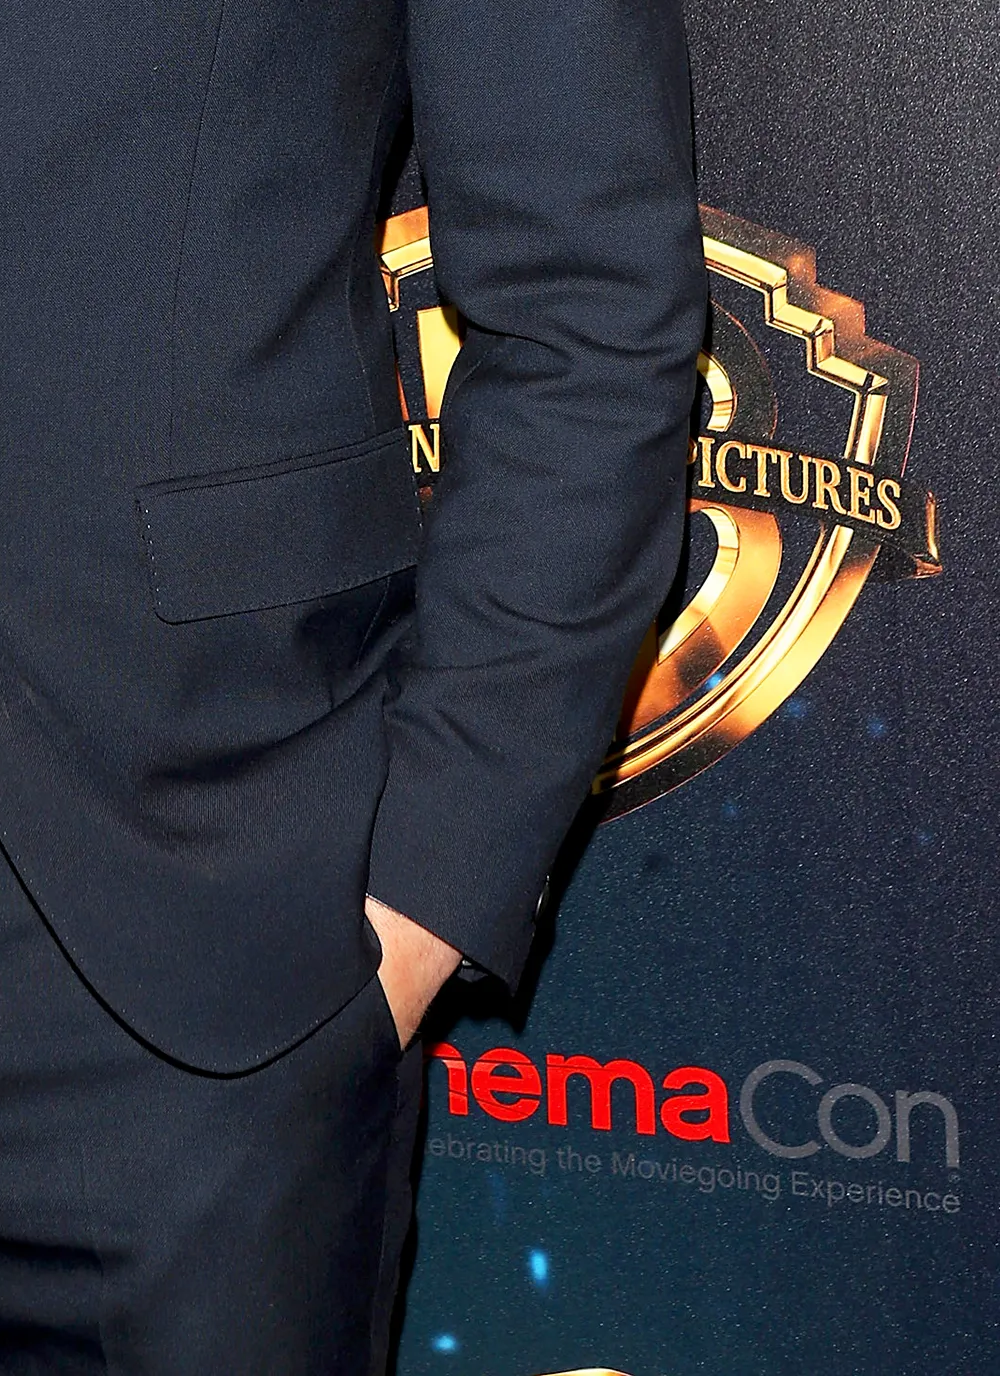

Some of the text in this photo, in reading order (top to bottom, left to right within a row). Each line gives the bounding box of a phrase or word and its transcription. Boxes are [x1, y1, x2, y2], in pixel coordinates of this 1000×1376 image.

[426, 1134, 962, 1215] ebrating the Moviegoing Experience
